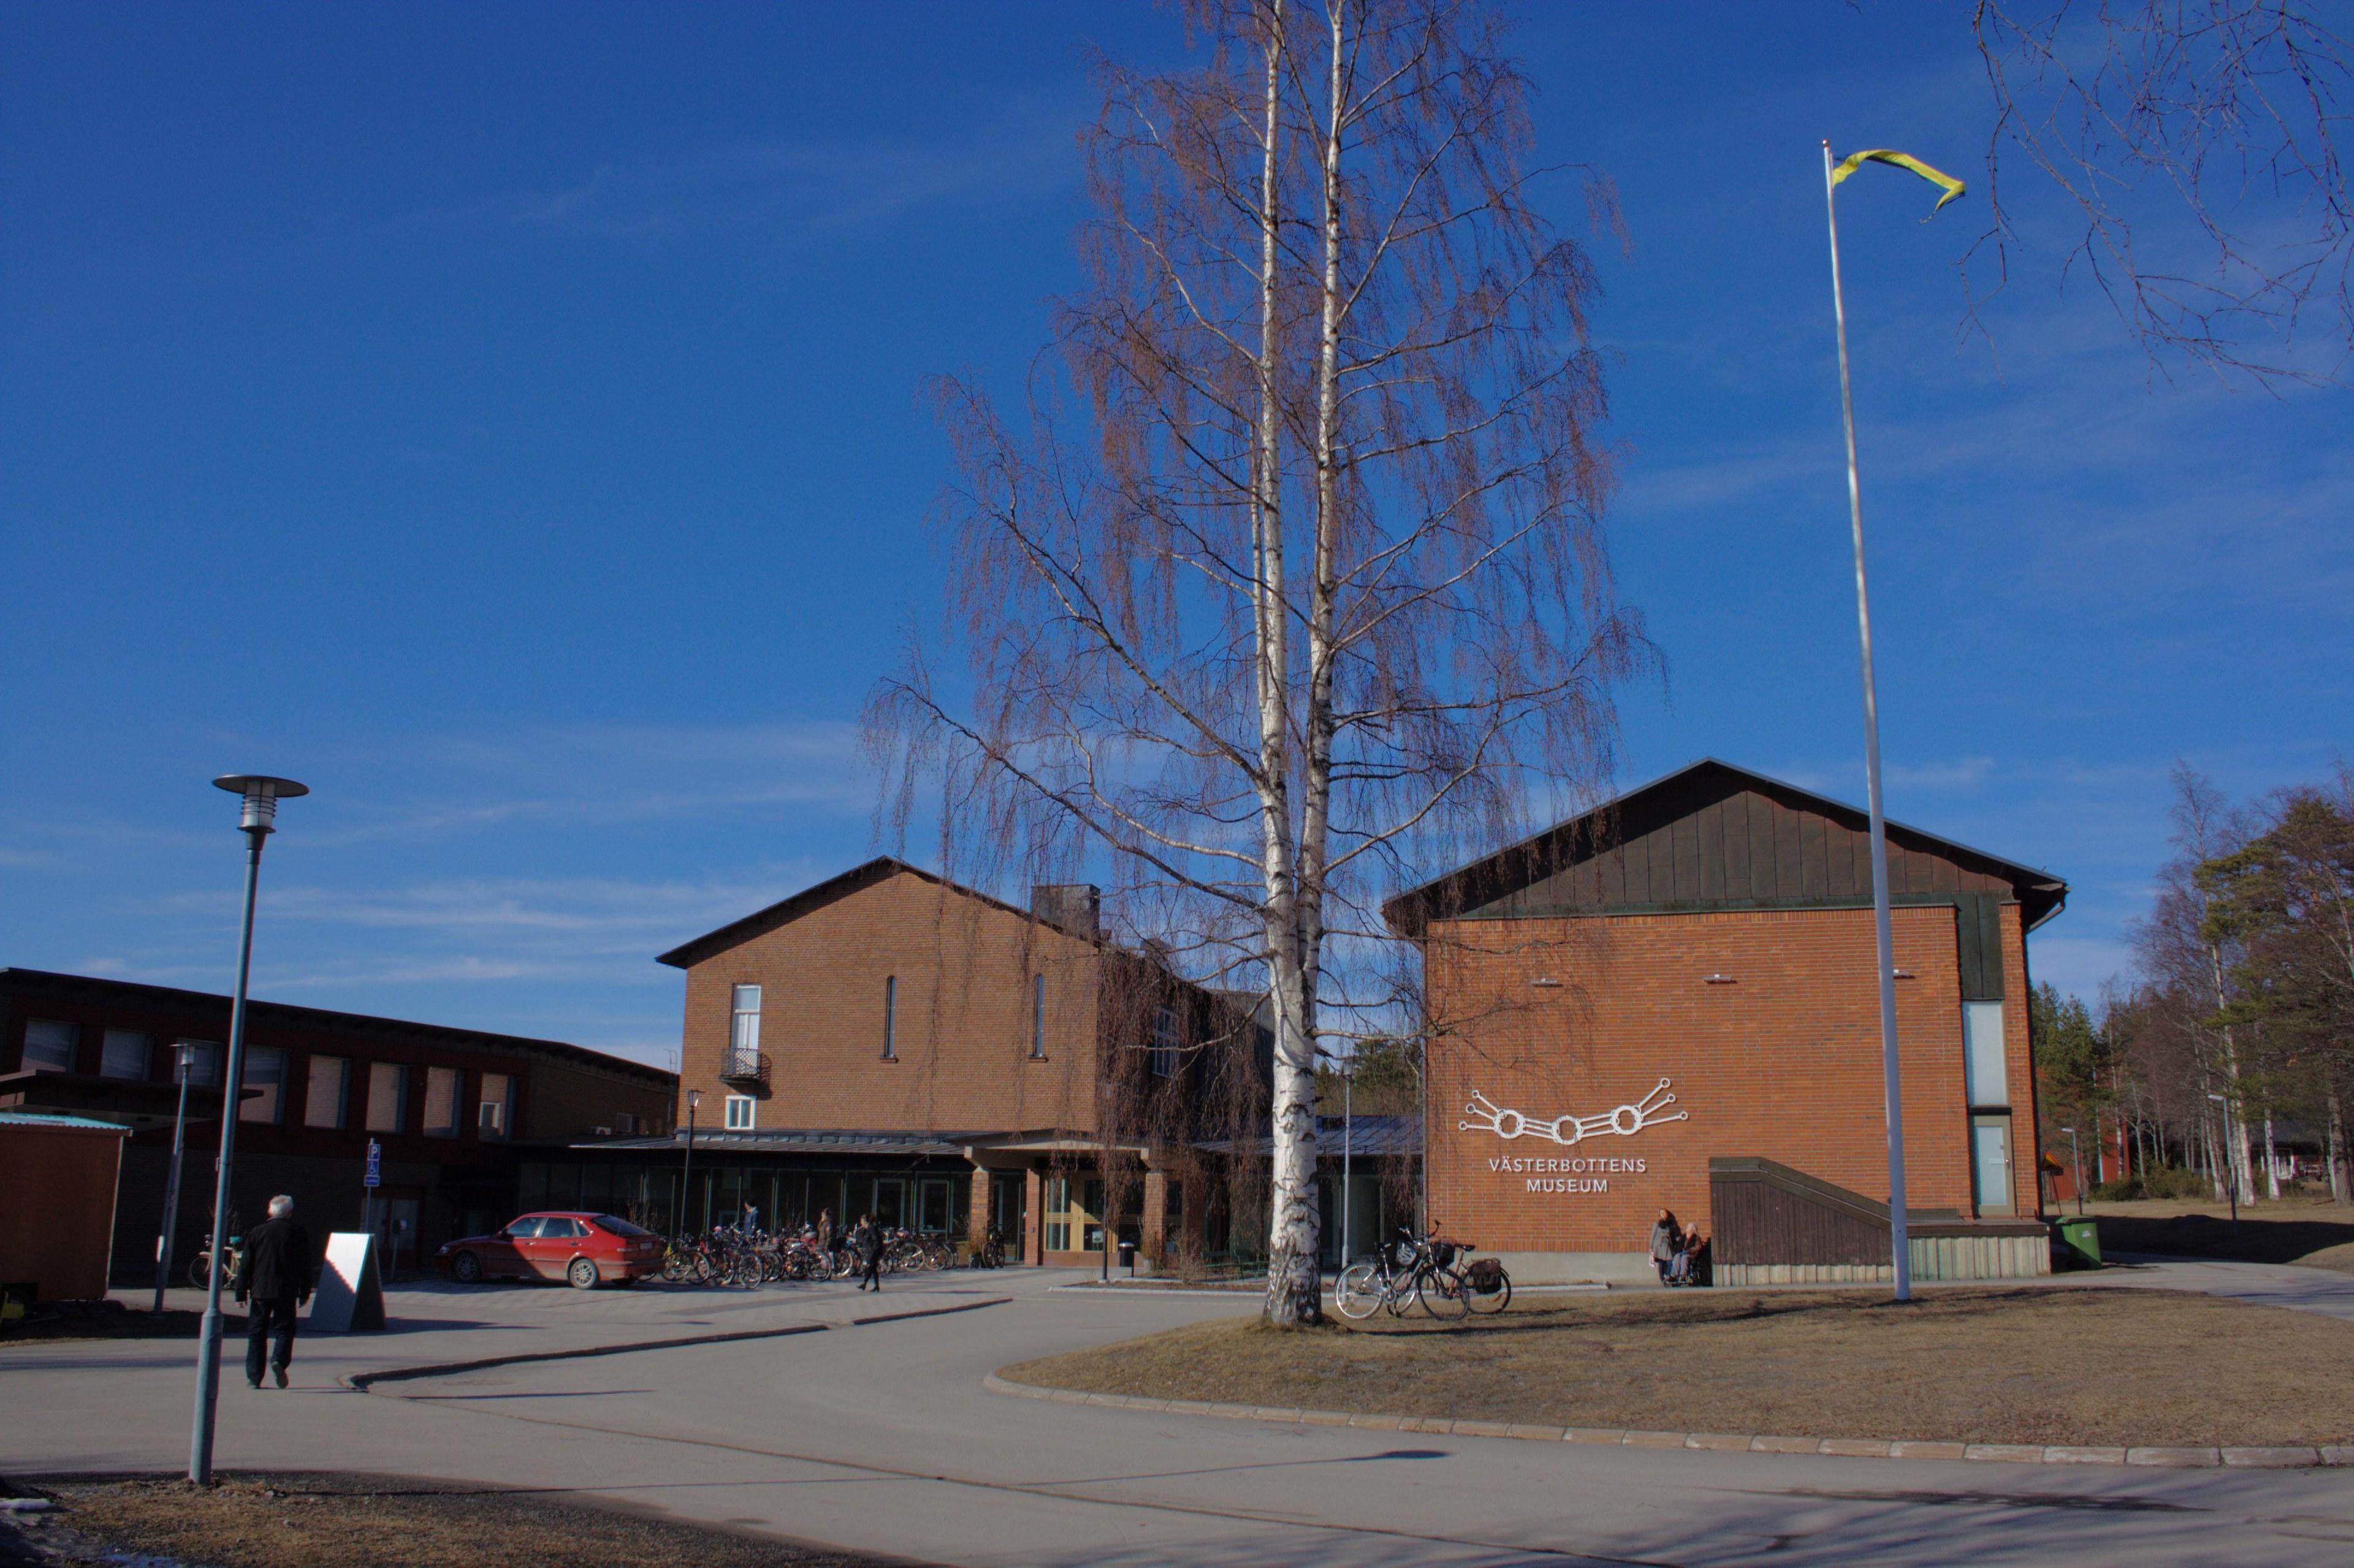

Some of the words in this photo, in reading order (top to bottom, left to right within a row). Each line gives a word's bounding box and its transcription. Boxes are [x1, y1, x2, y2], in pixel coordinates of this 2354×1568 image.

[371, 1146, 378, 1158] P
[1489, 1155, 1646, 1173] VÄSTERBOTTENS
[1526, 1178, 1608, 1193] MUSEUM
